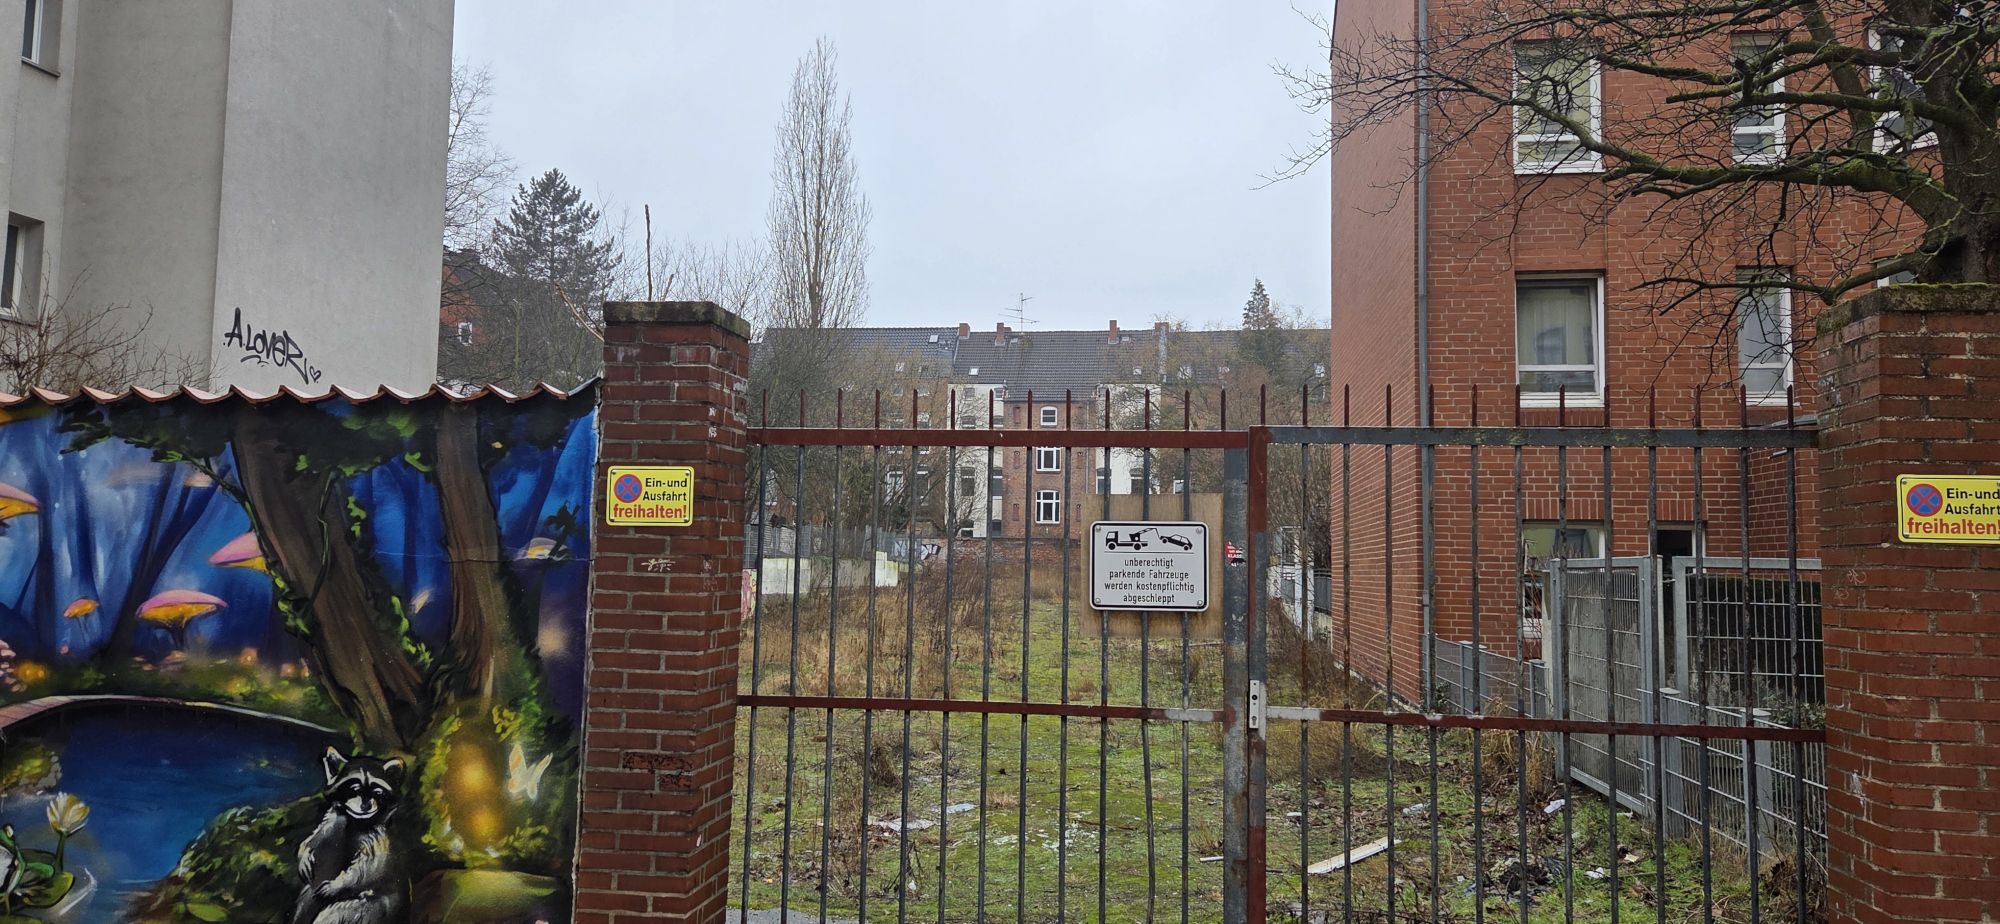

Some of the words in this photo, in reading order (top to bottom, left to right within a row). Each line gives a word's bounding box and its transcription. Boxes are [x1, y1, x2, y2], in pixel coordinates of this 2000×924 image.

[642, 491, 687, 501] Ausfahrt
[613, 503, 687, 518] freihalten!
[1944, 503, 2000, 516] Ausfahrt
[1124, 557, 1174, 569] unberechtigt
[1109, 569, 1146, 580] parkende
[1149, 569, 1189, 581] Fahrzeuge
[1104, 581, 1133, 590] werden
[1136, 582, 1195, 594] kostenpflichtig
[1123, 593, 1175, 604] abgeschleppt
